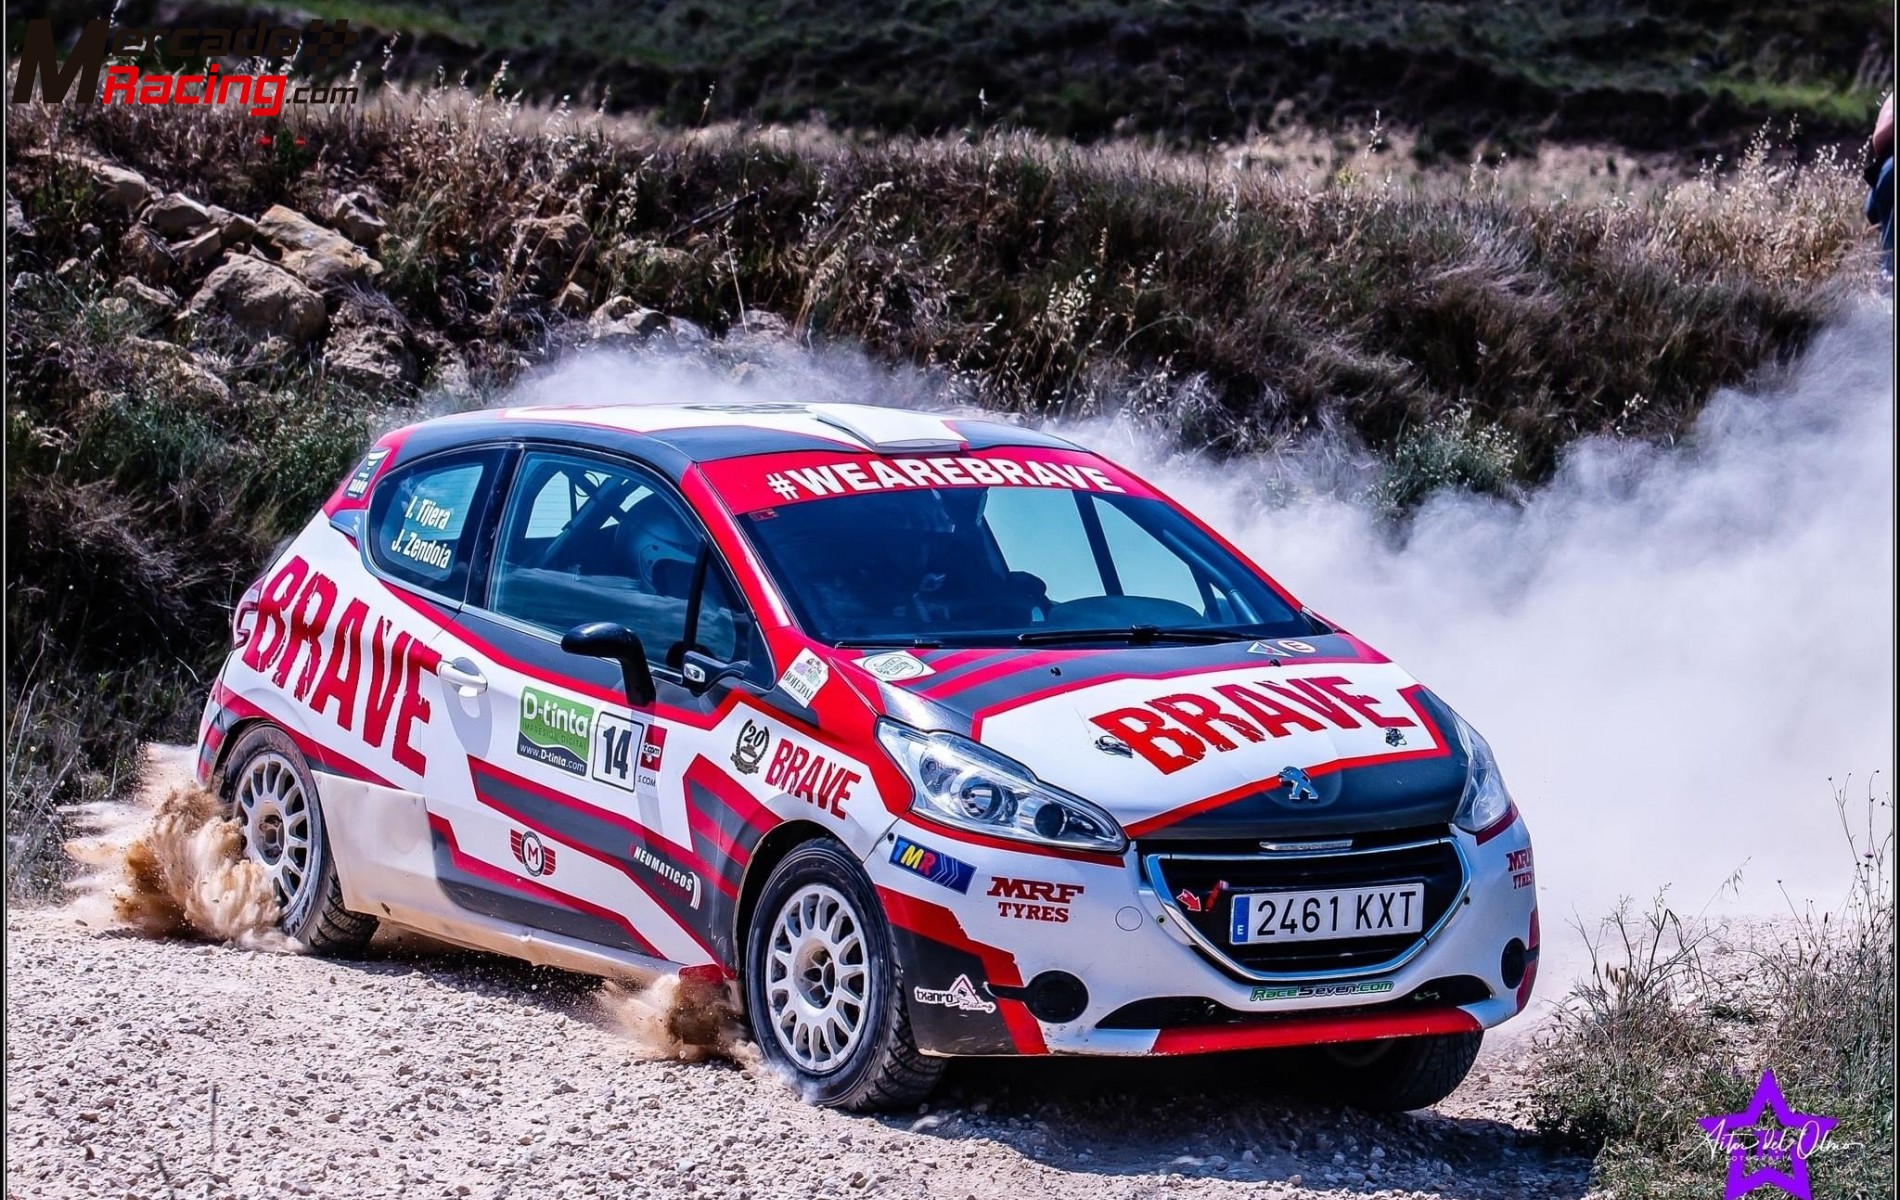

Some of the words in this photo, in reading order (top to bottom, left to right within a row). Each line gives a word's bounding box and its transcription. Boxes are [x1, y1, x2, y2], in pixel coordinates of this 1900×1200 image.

[766, 457, 1126, 500] #WEAREBRAVE
[405, 496, 418, 519] I.
[415, 498, 451, 531] Tijera
[391, 529, 405, 553] J.
[242, 555, 442, 778] BRAVE
[523, 692, 589, 739] D-tinta
[1089, 676, 1417, 775] BRAVE
[603, 725, 632, 780] 14
[743, 725, 766, 748] 20
[519, 743, 585, 772] www.D-tinta.com
[764, 738, 862, 821] BRAVE
[527, 842, 540, 866] M
[633, 845, 693, 892] NEUMATICOS
[892, 835, 936, 876] TMR
[987, 876, 1085, 904] MRF
[998, 902, 1069, 923] TYRES
[1237, 924, 1245, 935] E
[1257, 895, 1339, 936] 2461
[1355, 891, 1416, 930] KXT
[916, 989, 954, 1003] txanro
[1251, 981, 1395, 1001] RaceSeven.com
